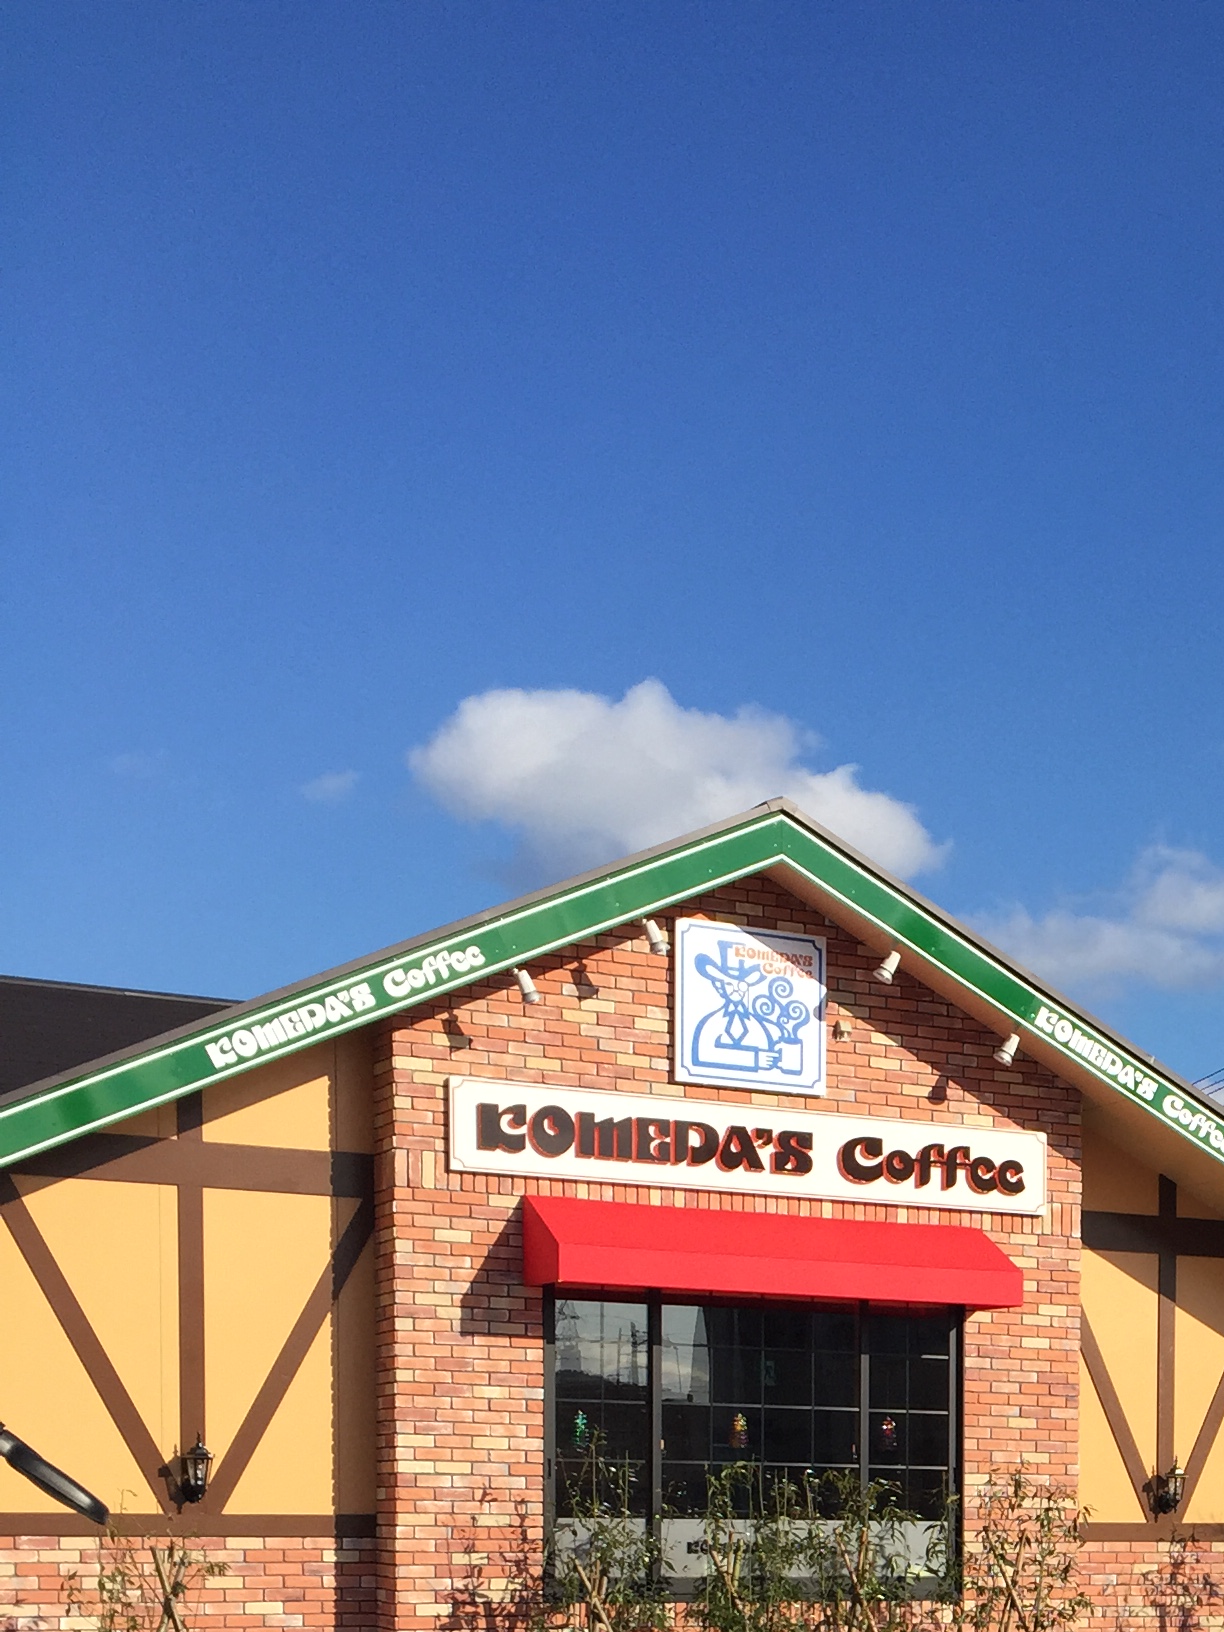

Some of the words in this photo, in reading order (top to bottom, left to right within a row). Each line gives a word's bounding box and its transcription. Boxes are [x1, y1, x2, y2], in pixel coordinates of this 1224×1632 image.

[734, 946, 813, 967] KOMEDA'S
[204, 981, 377, 1069] KOMEDA'S
[383, 945, 486, 998] Coffee
[1034, 1006, 1159, 1100] KOMEDA'S
[476, 1102, 814, 1174] KOMEDA'S
[838, 1136, 1026, 1196] Coffee
